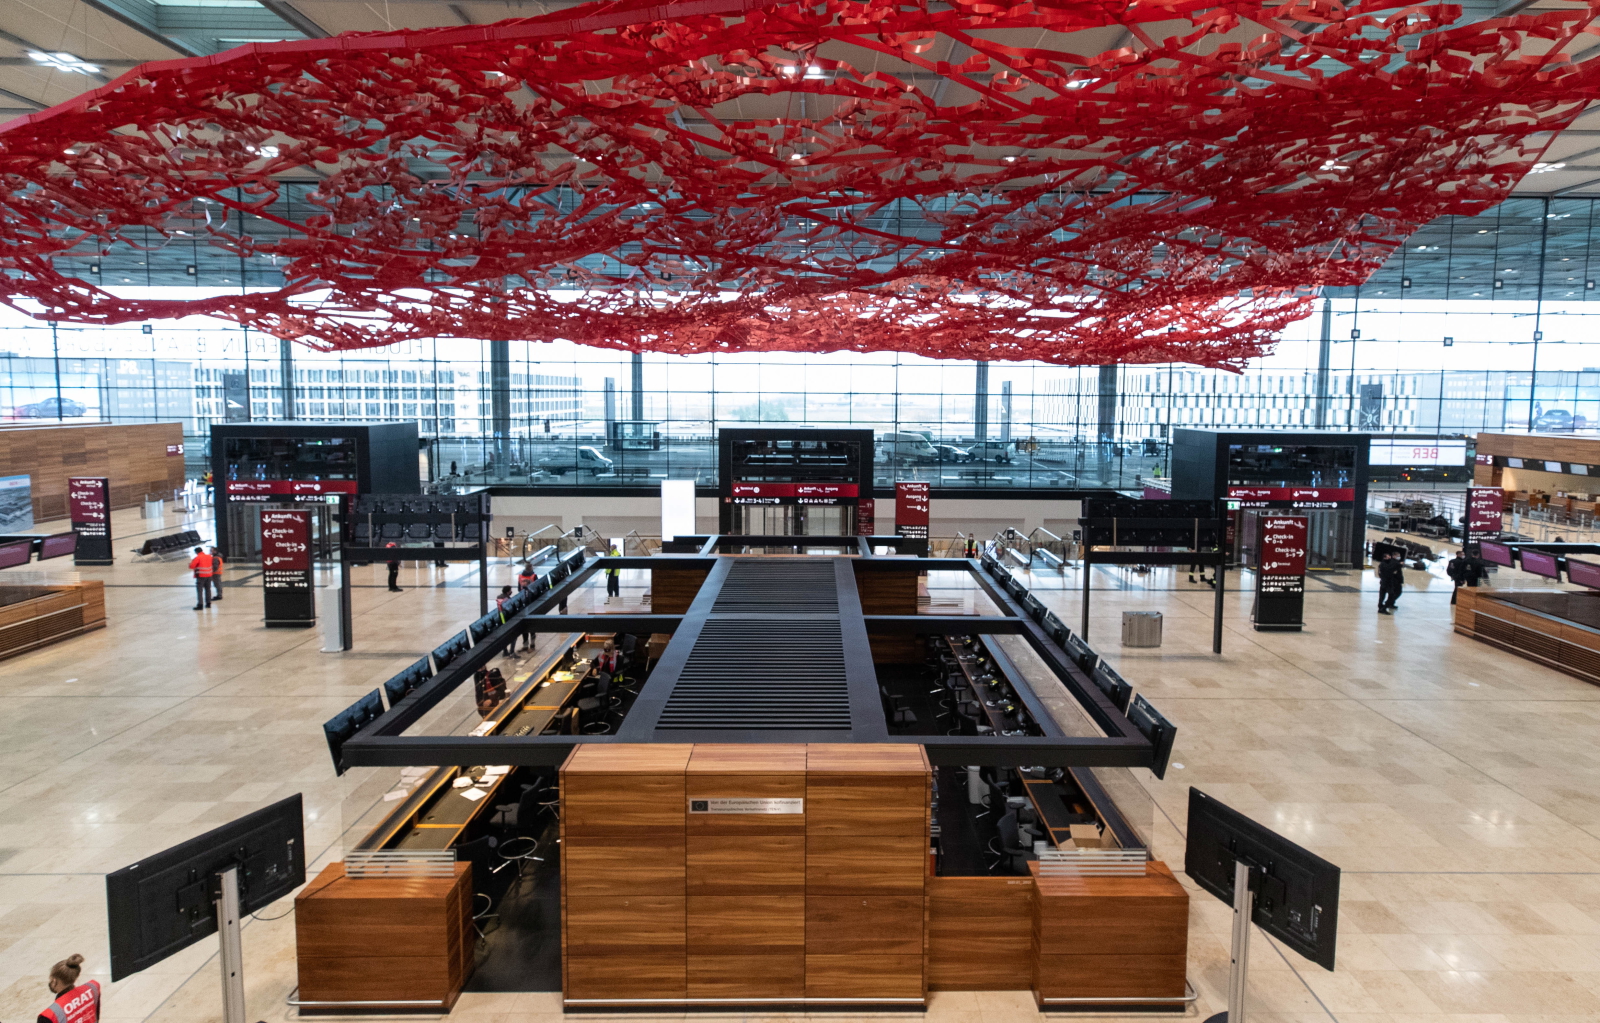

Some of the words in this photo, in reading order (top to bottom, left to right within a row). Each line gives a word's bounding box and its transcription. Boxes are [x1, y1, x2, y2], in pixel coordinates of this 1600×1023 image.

[177, 444, 184, 454] 3
[1486, 455, 1493, 465] 5
[63, 988, 94, 1014] ORAT
